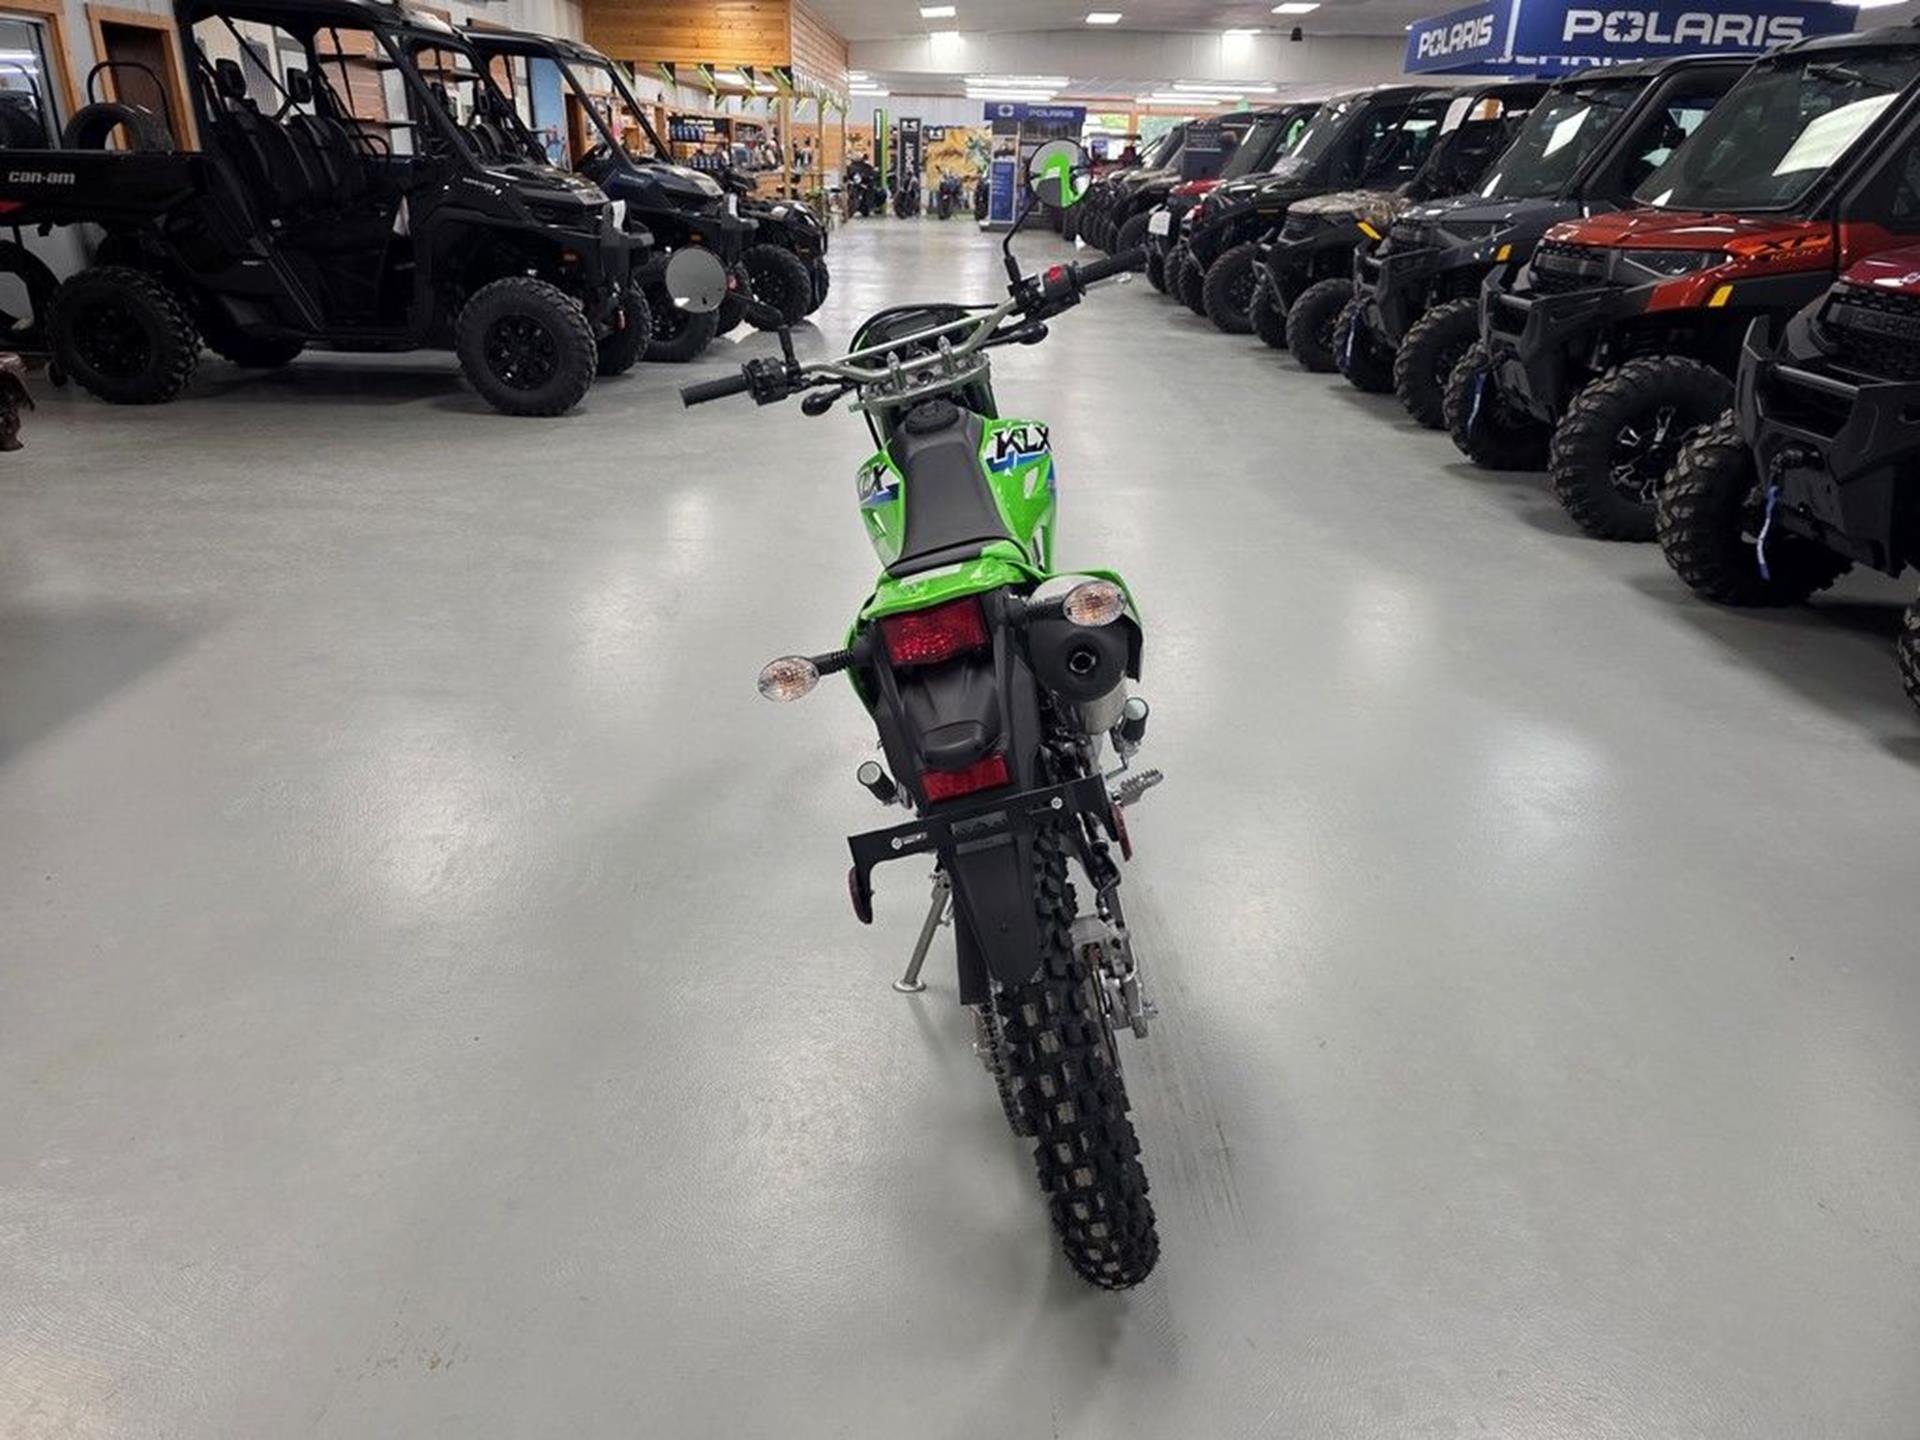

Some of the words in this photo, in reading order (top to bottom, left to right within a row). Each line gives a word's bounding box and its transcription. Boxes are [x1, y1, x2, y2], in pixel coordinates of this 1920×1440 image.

[1417, 14, 1494, 60] POLARIS
[1562, 10, 1805, 47] POLARIS
[1028, 108, 1076, 118] POLARIS
[993, 425, 1052, 460] KLX
